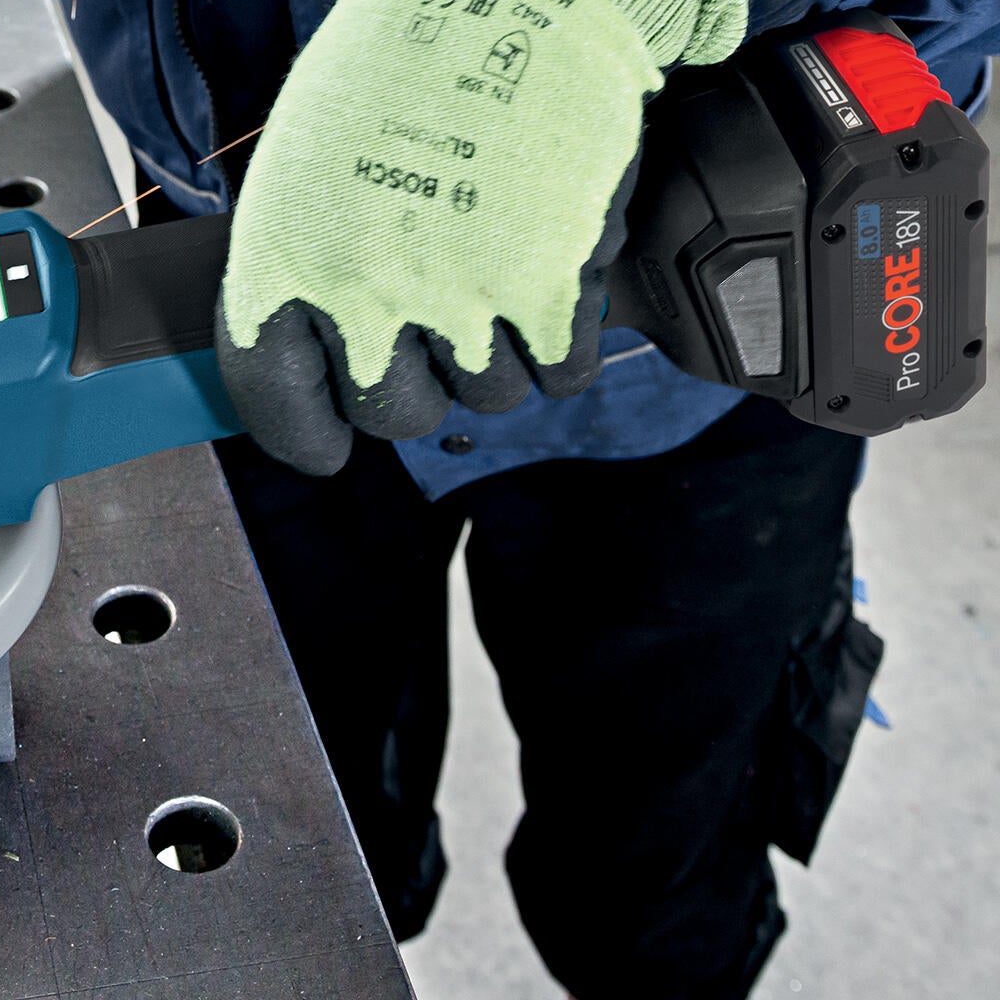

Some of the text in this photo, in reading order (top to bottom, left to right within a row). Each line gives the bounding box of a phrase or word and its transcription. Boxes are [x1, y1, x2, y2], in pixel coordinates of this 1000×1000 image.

[511, 1, 553, 29] 4542
[354, 156, 439, 198] BOSCH
[860, 208, 878, 256] 8.0 Ah
